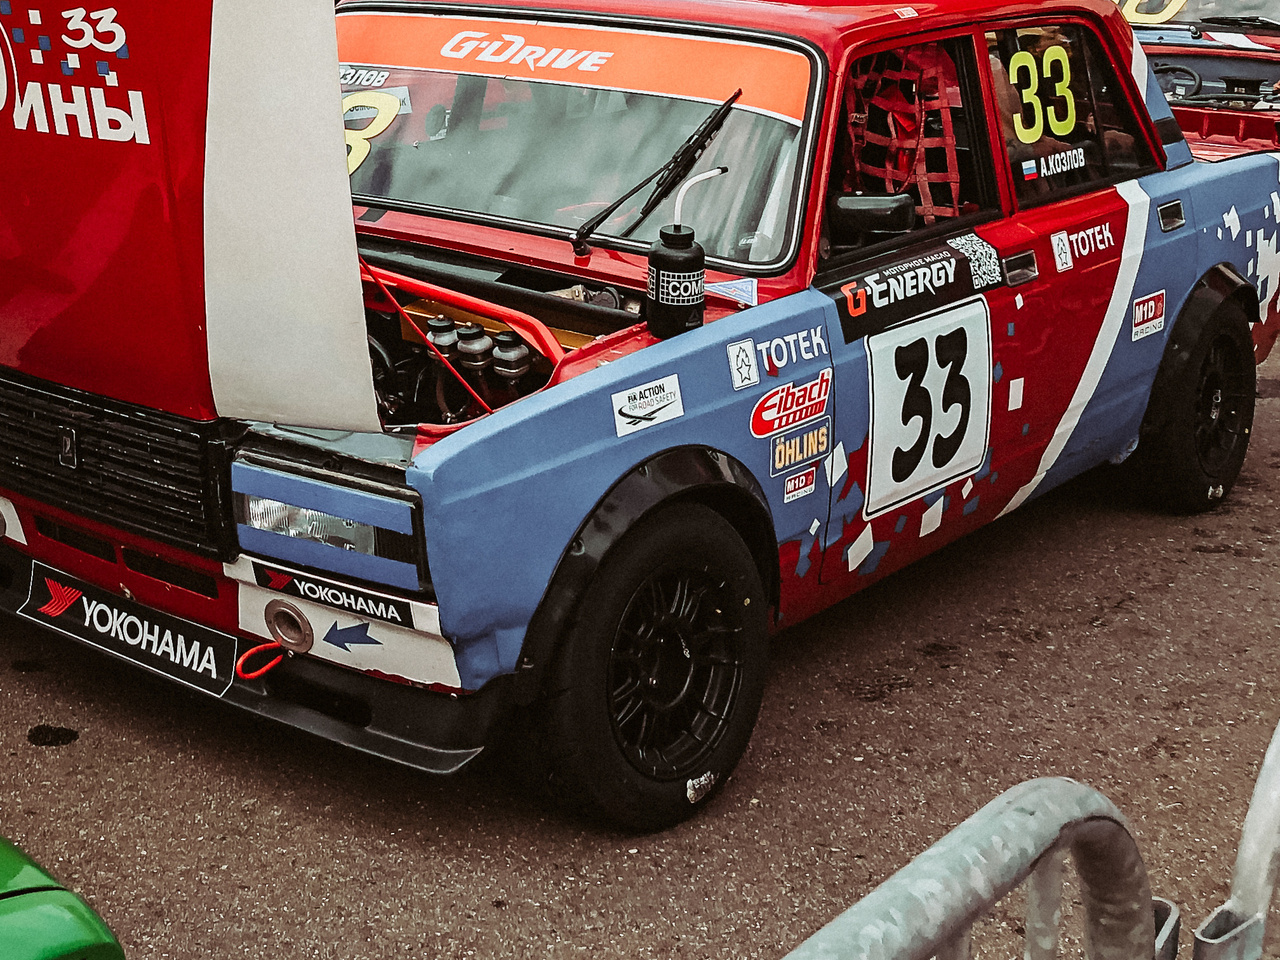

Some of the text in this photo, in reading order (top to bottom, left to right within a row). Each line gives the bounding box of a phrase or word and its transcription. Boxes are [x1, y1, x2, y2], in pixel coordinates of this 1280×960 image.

[61, 7, 126, 53] 33
[1009, 46, 1076, 144] 33
[1069, 224, 1115, 259] TOTEK
[1134, 302, 1156, 324] M1D
[1134, 320, 1164, 338] RACING
[757, 325, 828, 372] TOTEK
[638, 398, 655, 410] ROAD
[656, 390, 677, 405] SAFETY
[639, 383, 666, 401] ACTION
[751, 372, 830, 437] Eibach
[891, 326, 971, 484] 33
[775, 426, 828, 470] ÖHLINS
[787, 477, 806, 492] M1D
[293, 578, 402, 622] YOKOHAMA
[81, 596, 218, 679] YOKOHAMA
